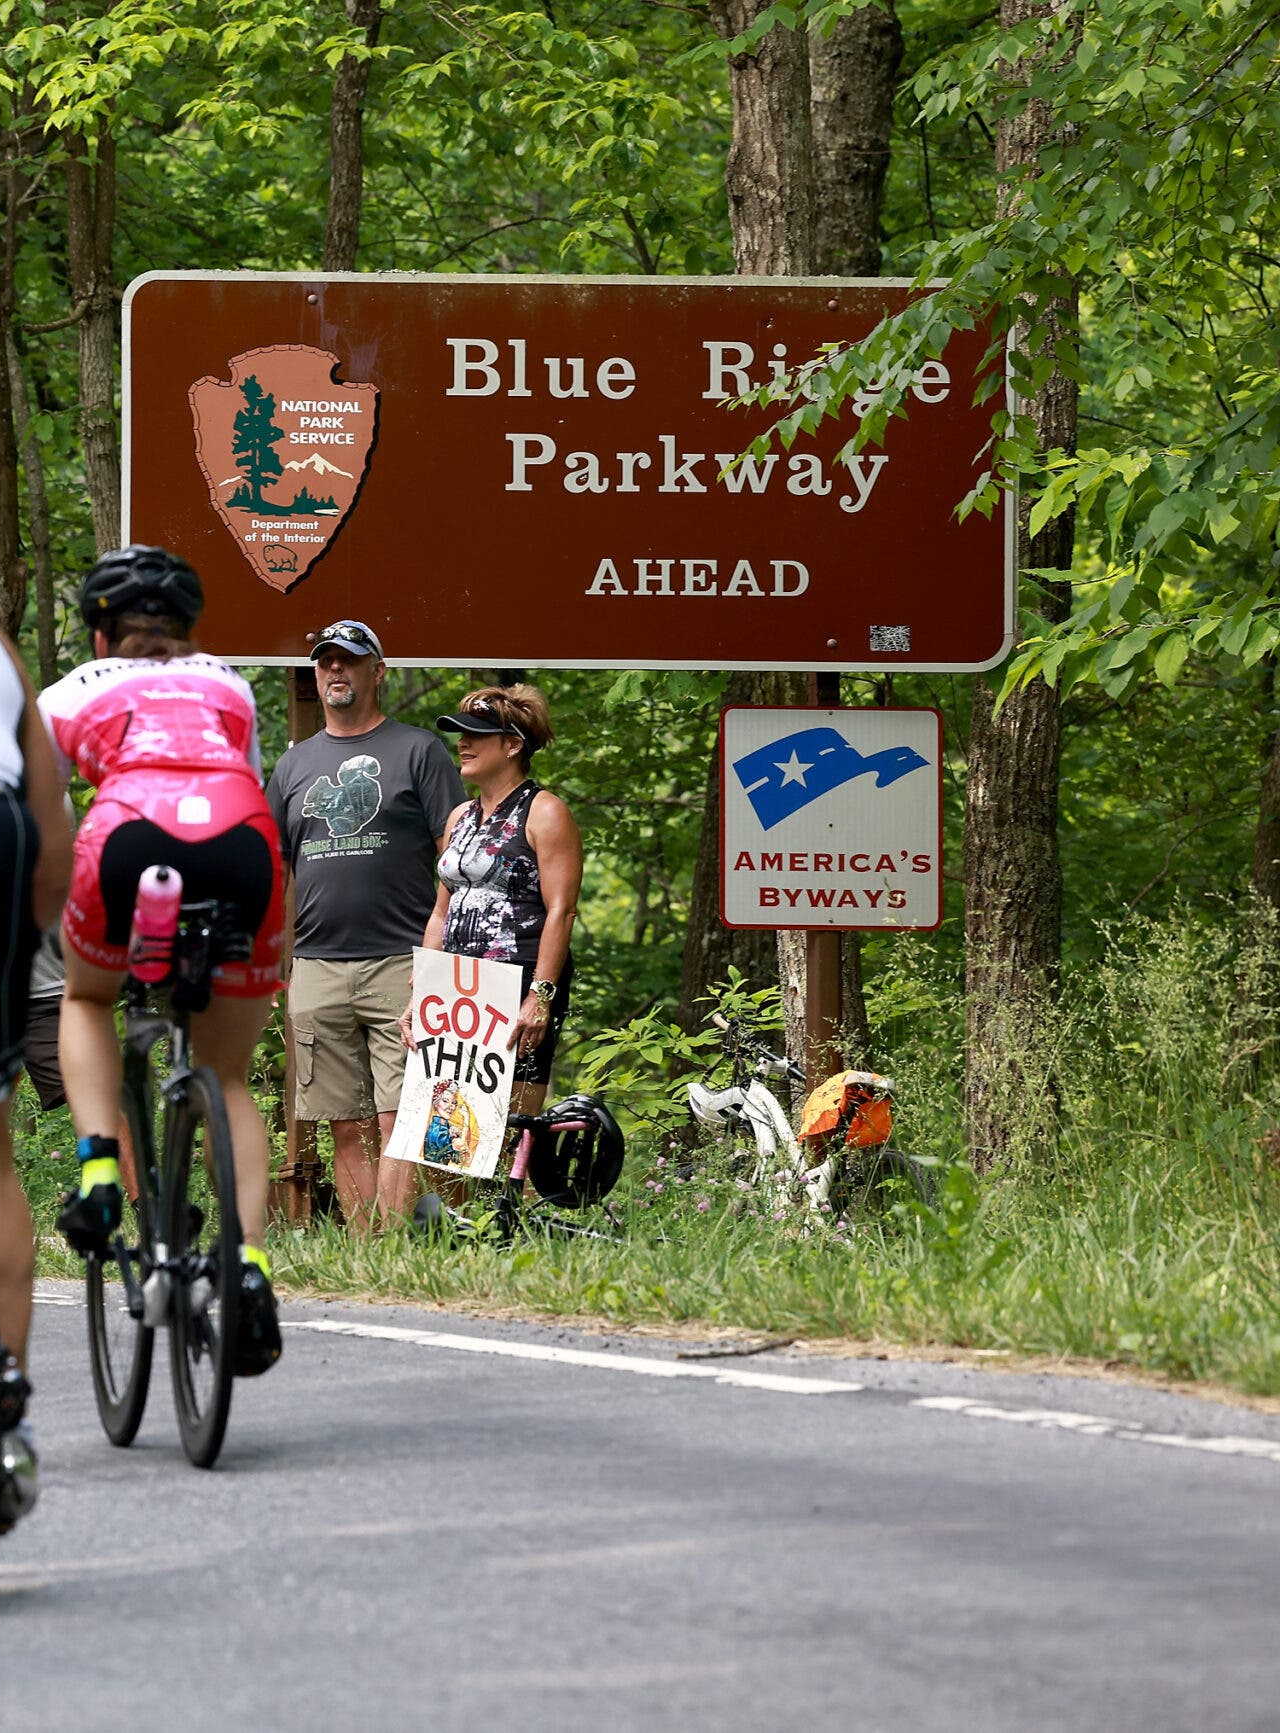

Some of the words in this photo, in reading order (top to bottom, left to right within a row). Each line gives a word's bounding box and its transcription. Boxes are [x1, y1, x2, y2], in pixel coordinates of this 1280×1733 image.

[445, 338, 637, 400] Blue
[280, 400, 363, 413] NATIONAL
[299, 416, 344, 429] PARK
[289, 432, 355, 445] SERVICE
[504, 433, 889, 513] Parkway
[251, 519, 319, 531] Department
[244, 532, 258, 543] of
[261, 532, 280, 543] the
[284, 533, 326, 544] Interior
[584, 558, 811, 598] AHEAD
[334, 836, 361, 851] LAND
[733, 850, 932, 874] AMERICA'S
[759, 887, 907, 909] BYWAYS
[453, 955, 479, 997] U
[420, 994, 509, 1046] GOT
[416, 1037, 505, 1094] THIS
